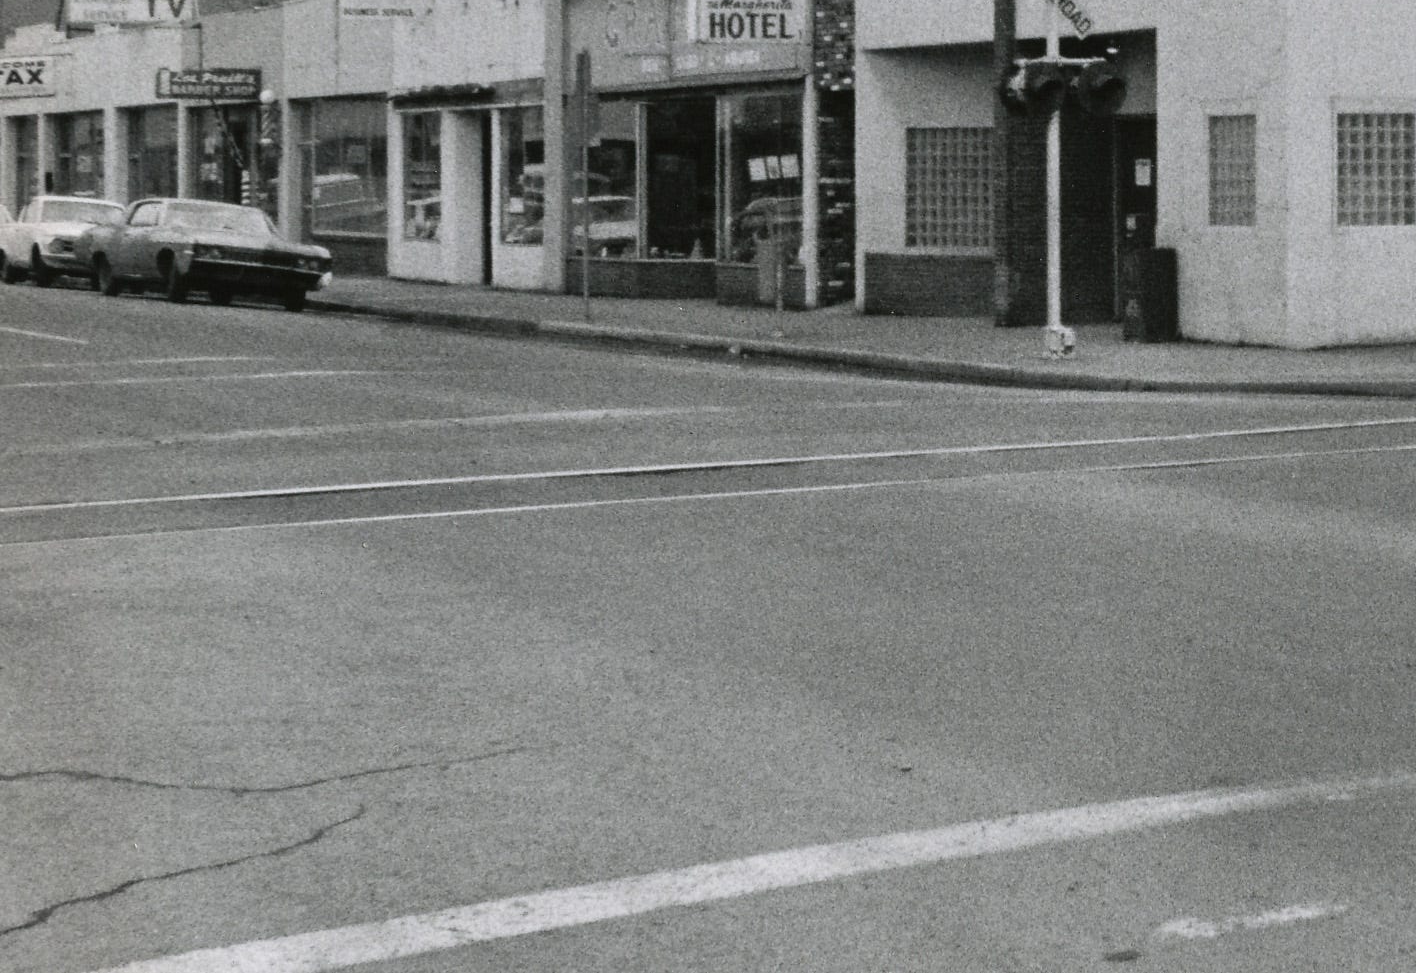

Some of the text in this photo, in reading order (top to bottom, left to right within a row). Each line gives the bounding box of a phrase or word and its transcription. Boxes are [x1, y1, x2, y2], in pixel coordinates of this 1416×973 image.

[709, 12, 796, 40] HOTEL
[2, 60, 46, 69] COME
[0, 68, 45, 85] AX
